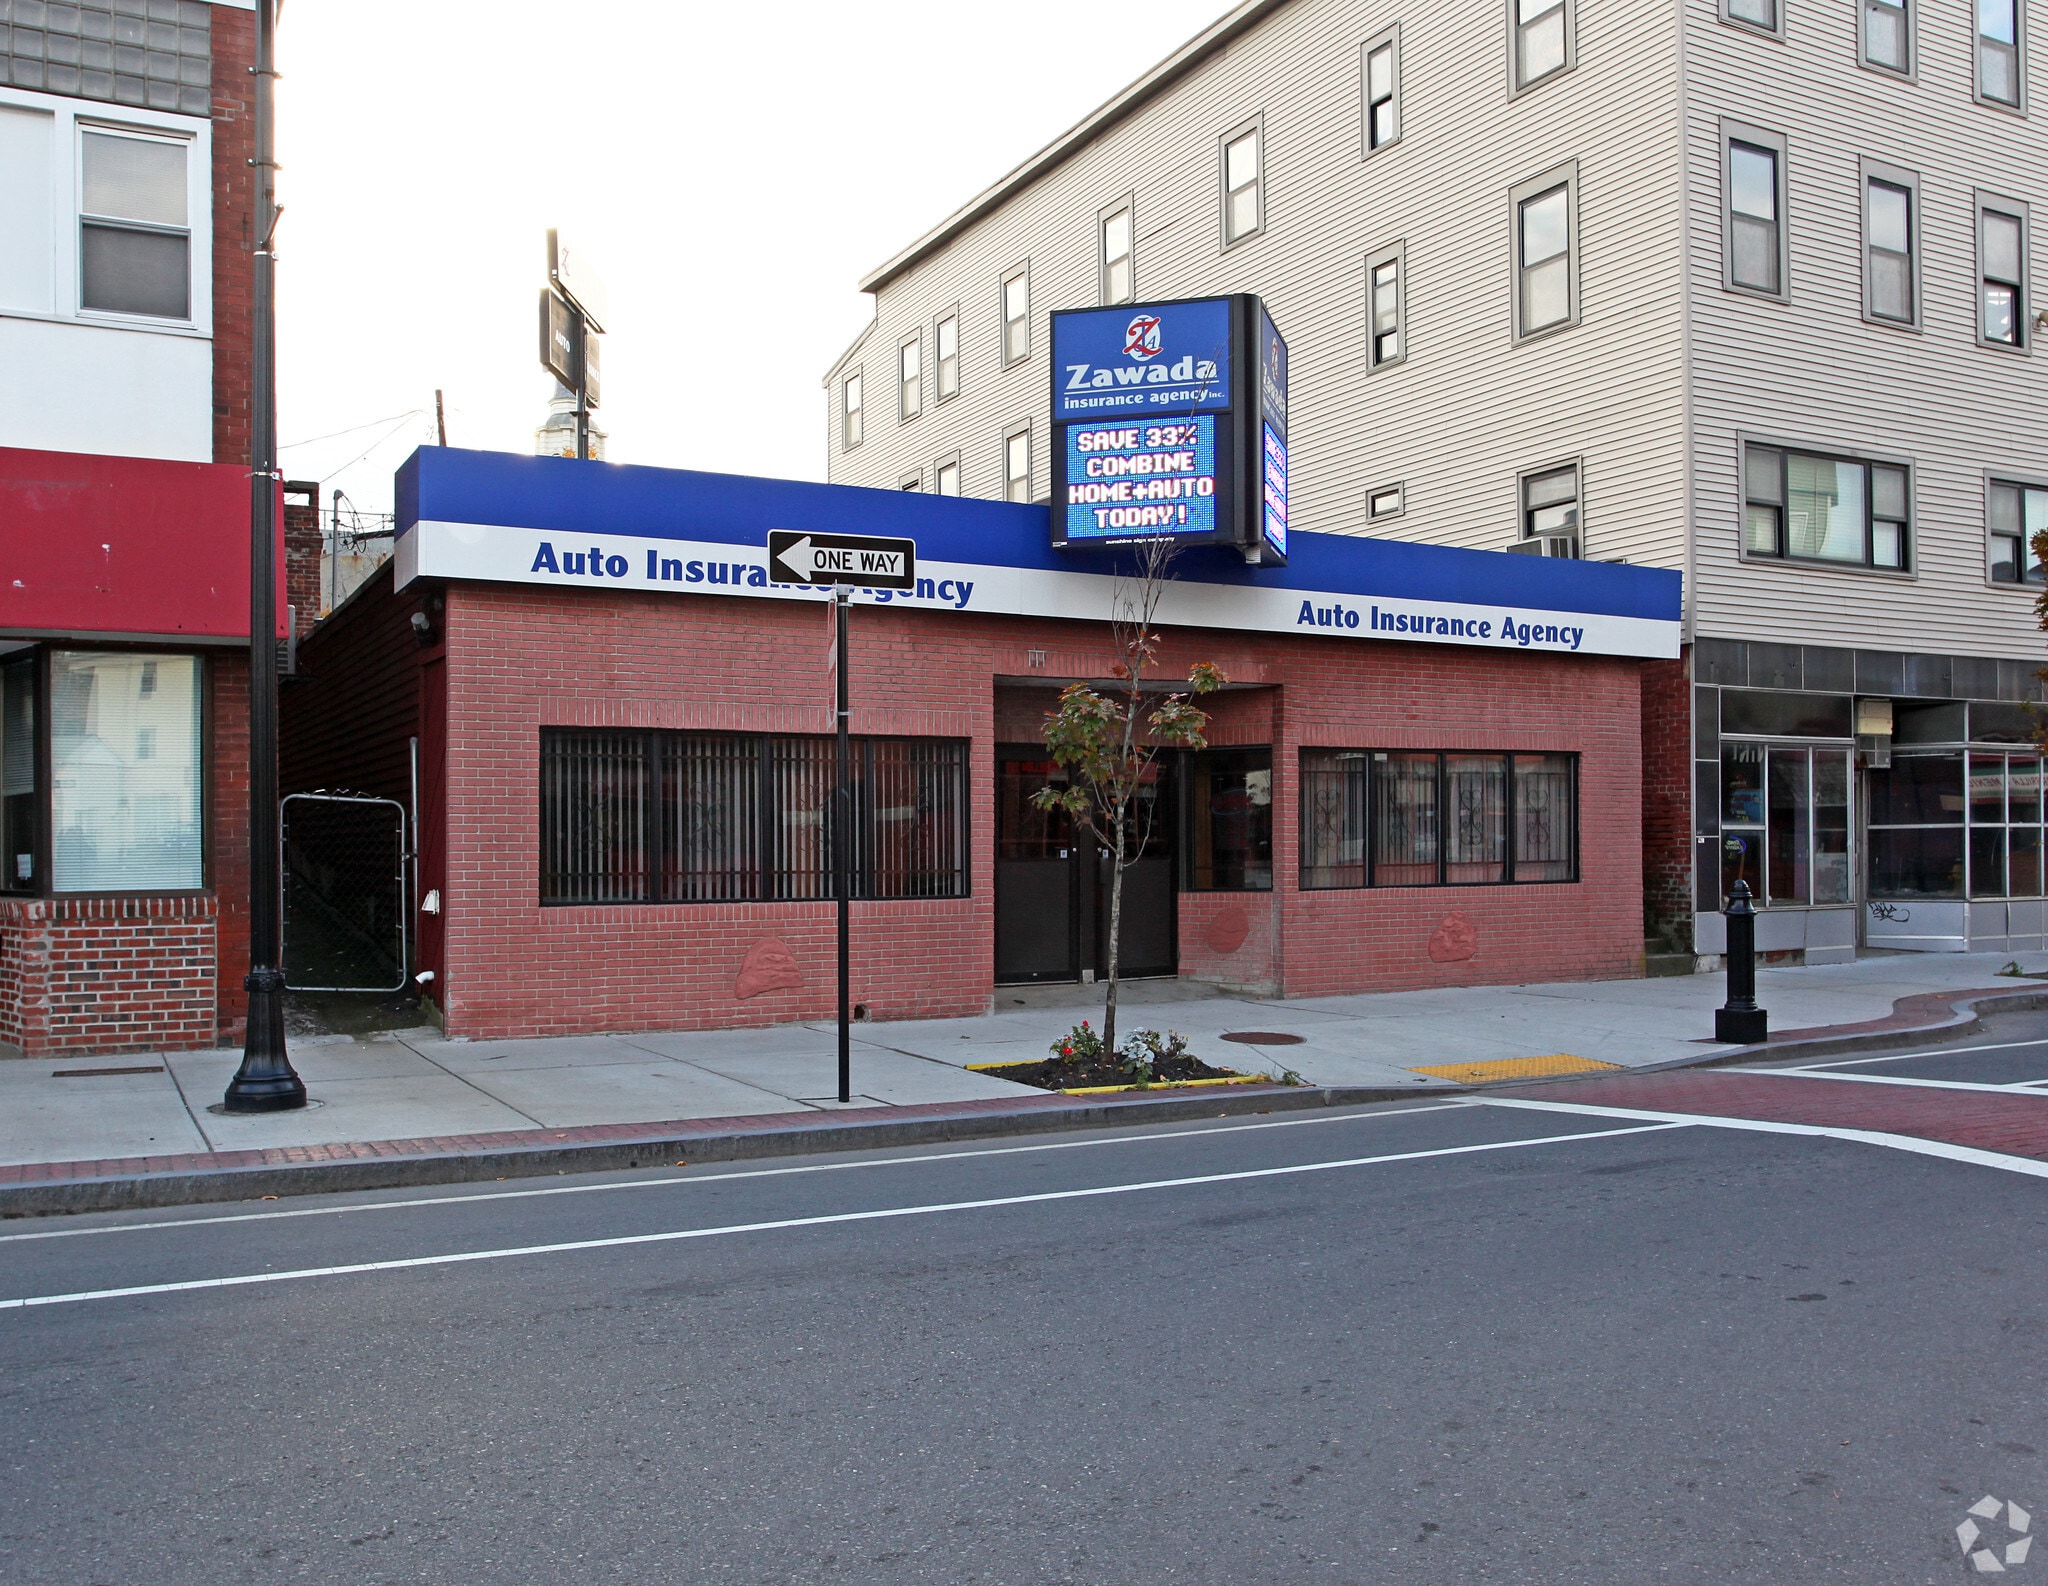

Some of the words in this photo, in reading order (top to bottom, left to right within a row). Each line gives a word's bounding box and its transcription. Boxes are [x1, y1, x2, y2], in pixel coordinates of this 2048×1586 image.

[555, 329, 571, 353] AUTO
[1065, 355, 1218, 390] Zawada
[1064, 394, 1144, 410] insurance
[1149, 389, 1209, 405] agency
[1077, 429, 1139, 452] SAVE
[1146, 425, 1198, 447] 33%
[1086, 451, 1195, 477] COMBINE
[1068, 477, 1214, 504] HOME+AUTO
[530, 542, 629, 577] Auto
[813, 549, 853, 570] ONE
[860, 552, 900, 573] WAY
[1297, 600, 1360, 629] Auto
[1371, 605, 1492, 639] Insurance
[1500, 616, 1584, 651] Agency
